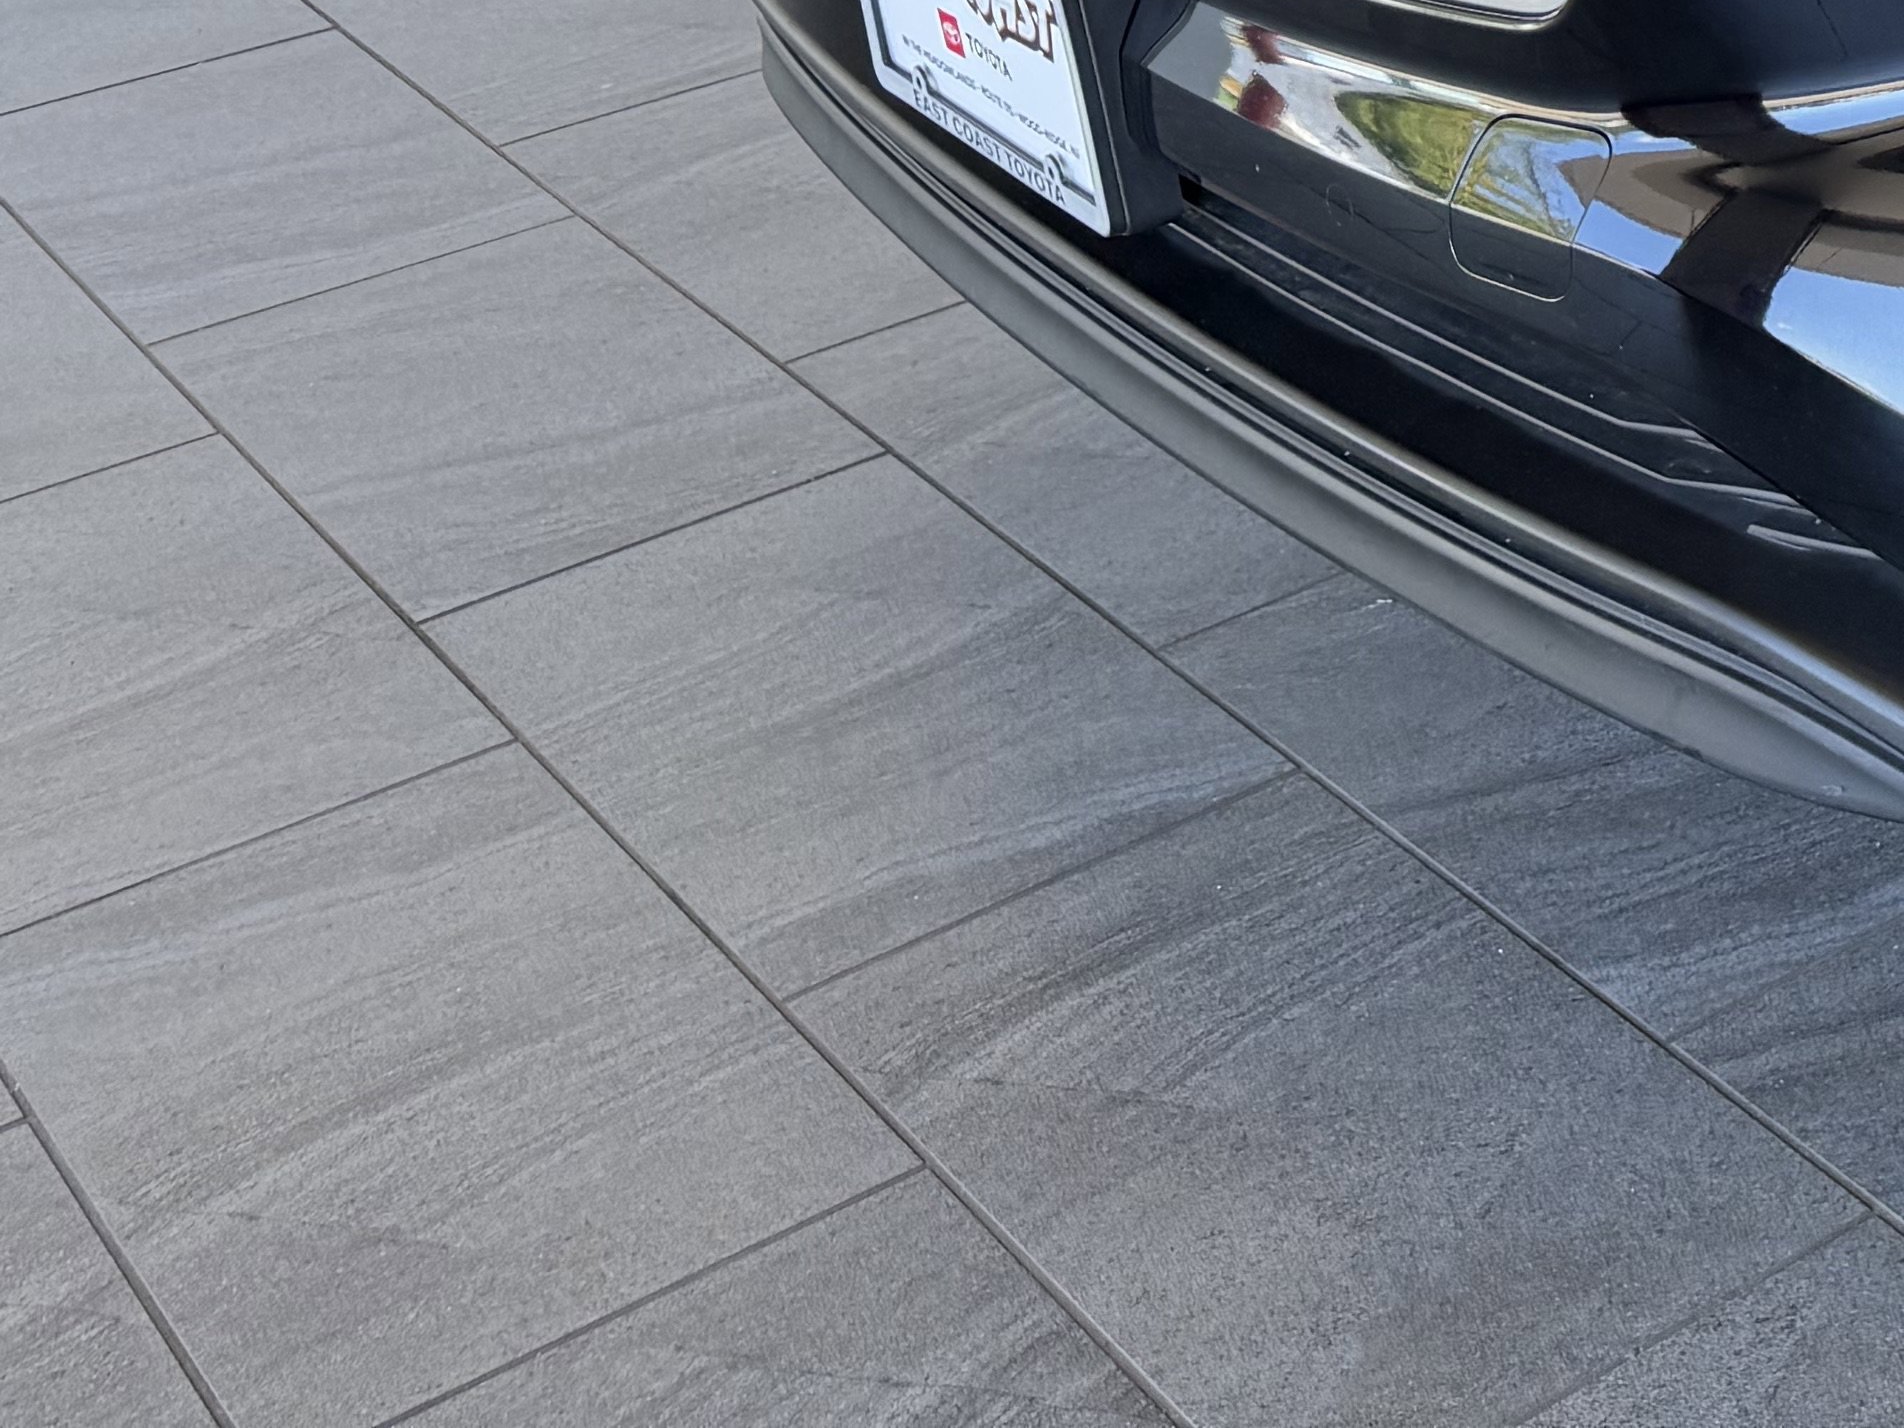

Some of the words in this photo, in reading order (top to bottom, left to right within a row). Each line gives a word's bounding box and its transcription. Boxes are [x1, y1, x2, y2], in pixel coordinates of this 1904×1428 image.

[965, 32, 1013, 81] TOYOTA
[913, 88, 949, 125] EAST
[952, 116, 1000, 162] COAST
[1005, 151, 1067, 206] TOYOTA
